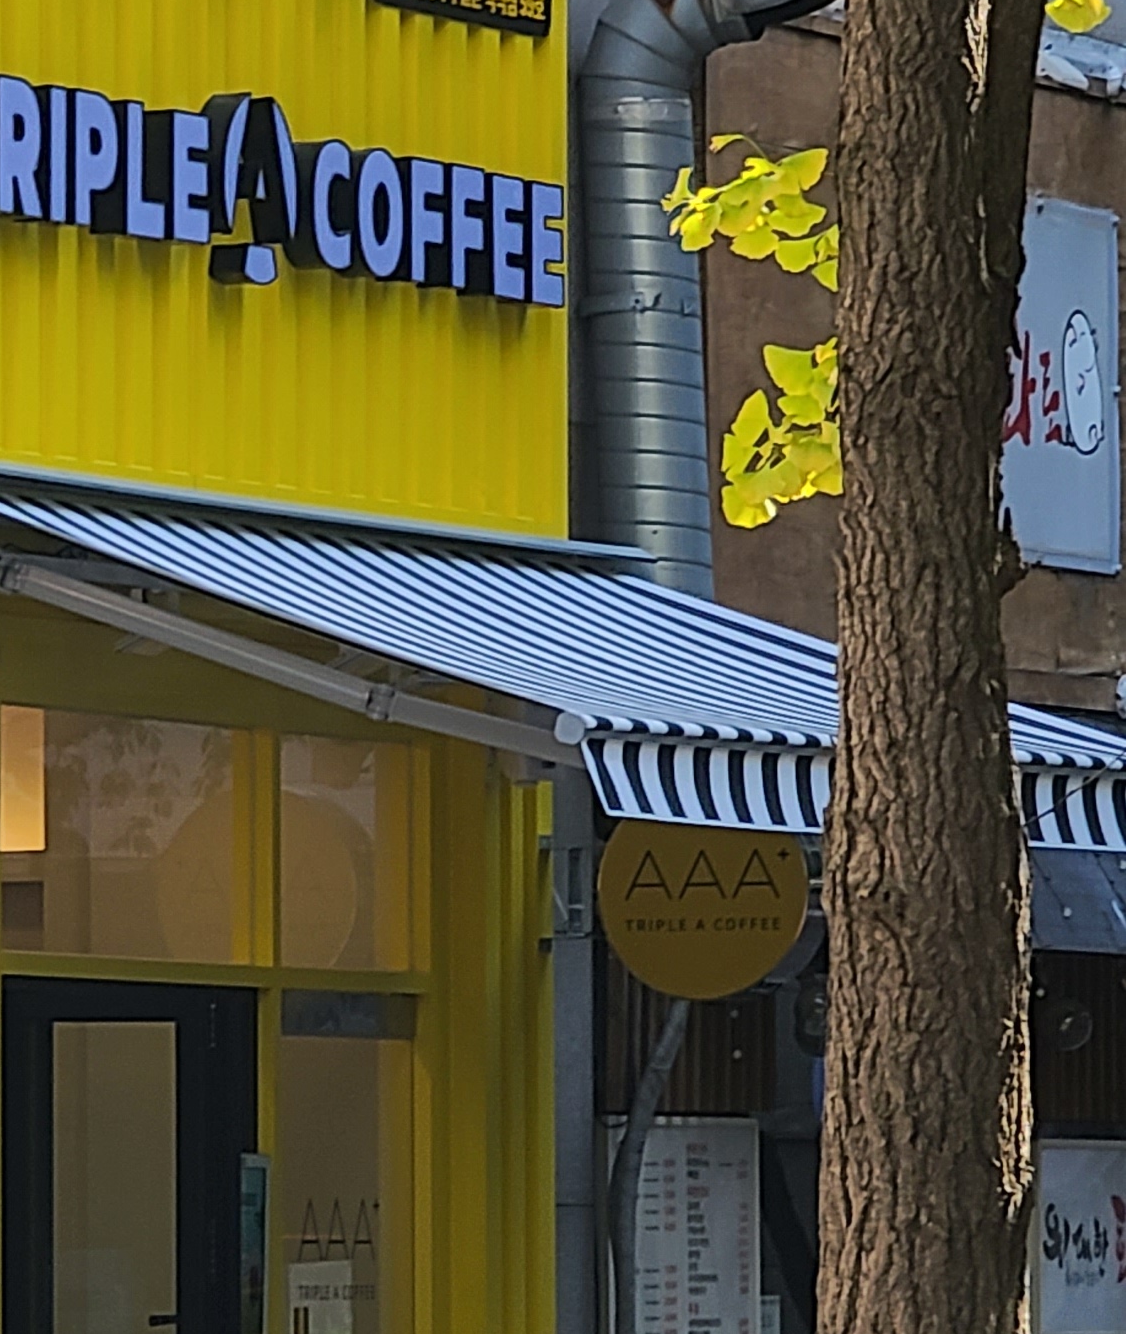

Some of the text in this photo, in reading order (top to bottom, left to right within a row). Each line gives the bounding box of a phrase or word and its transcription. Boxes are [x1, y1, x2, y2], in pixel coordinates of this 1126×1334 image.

[312, 138, 565, 309] COFFEE
[626, 918, 781, 932] TRIPLE A COFFEE
